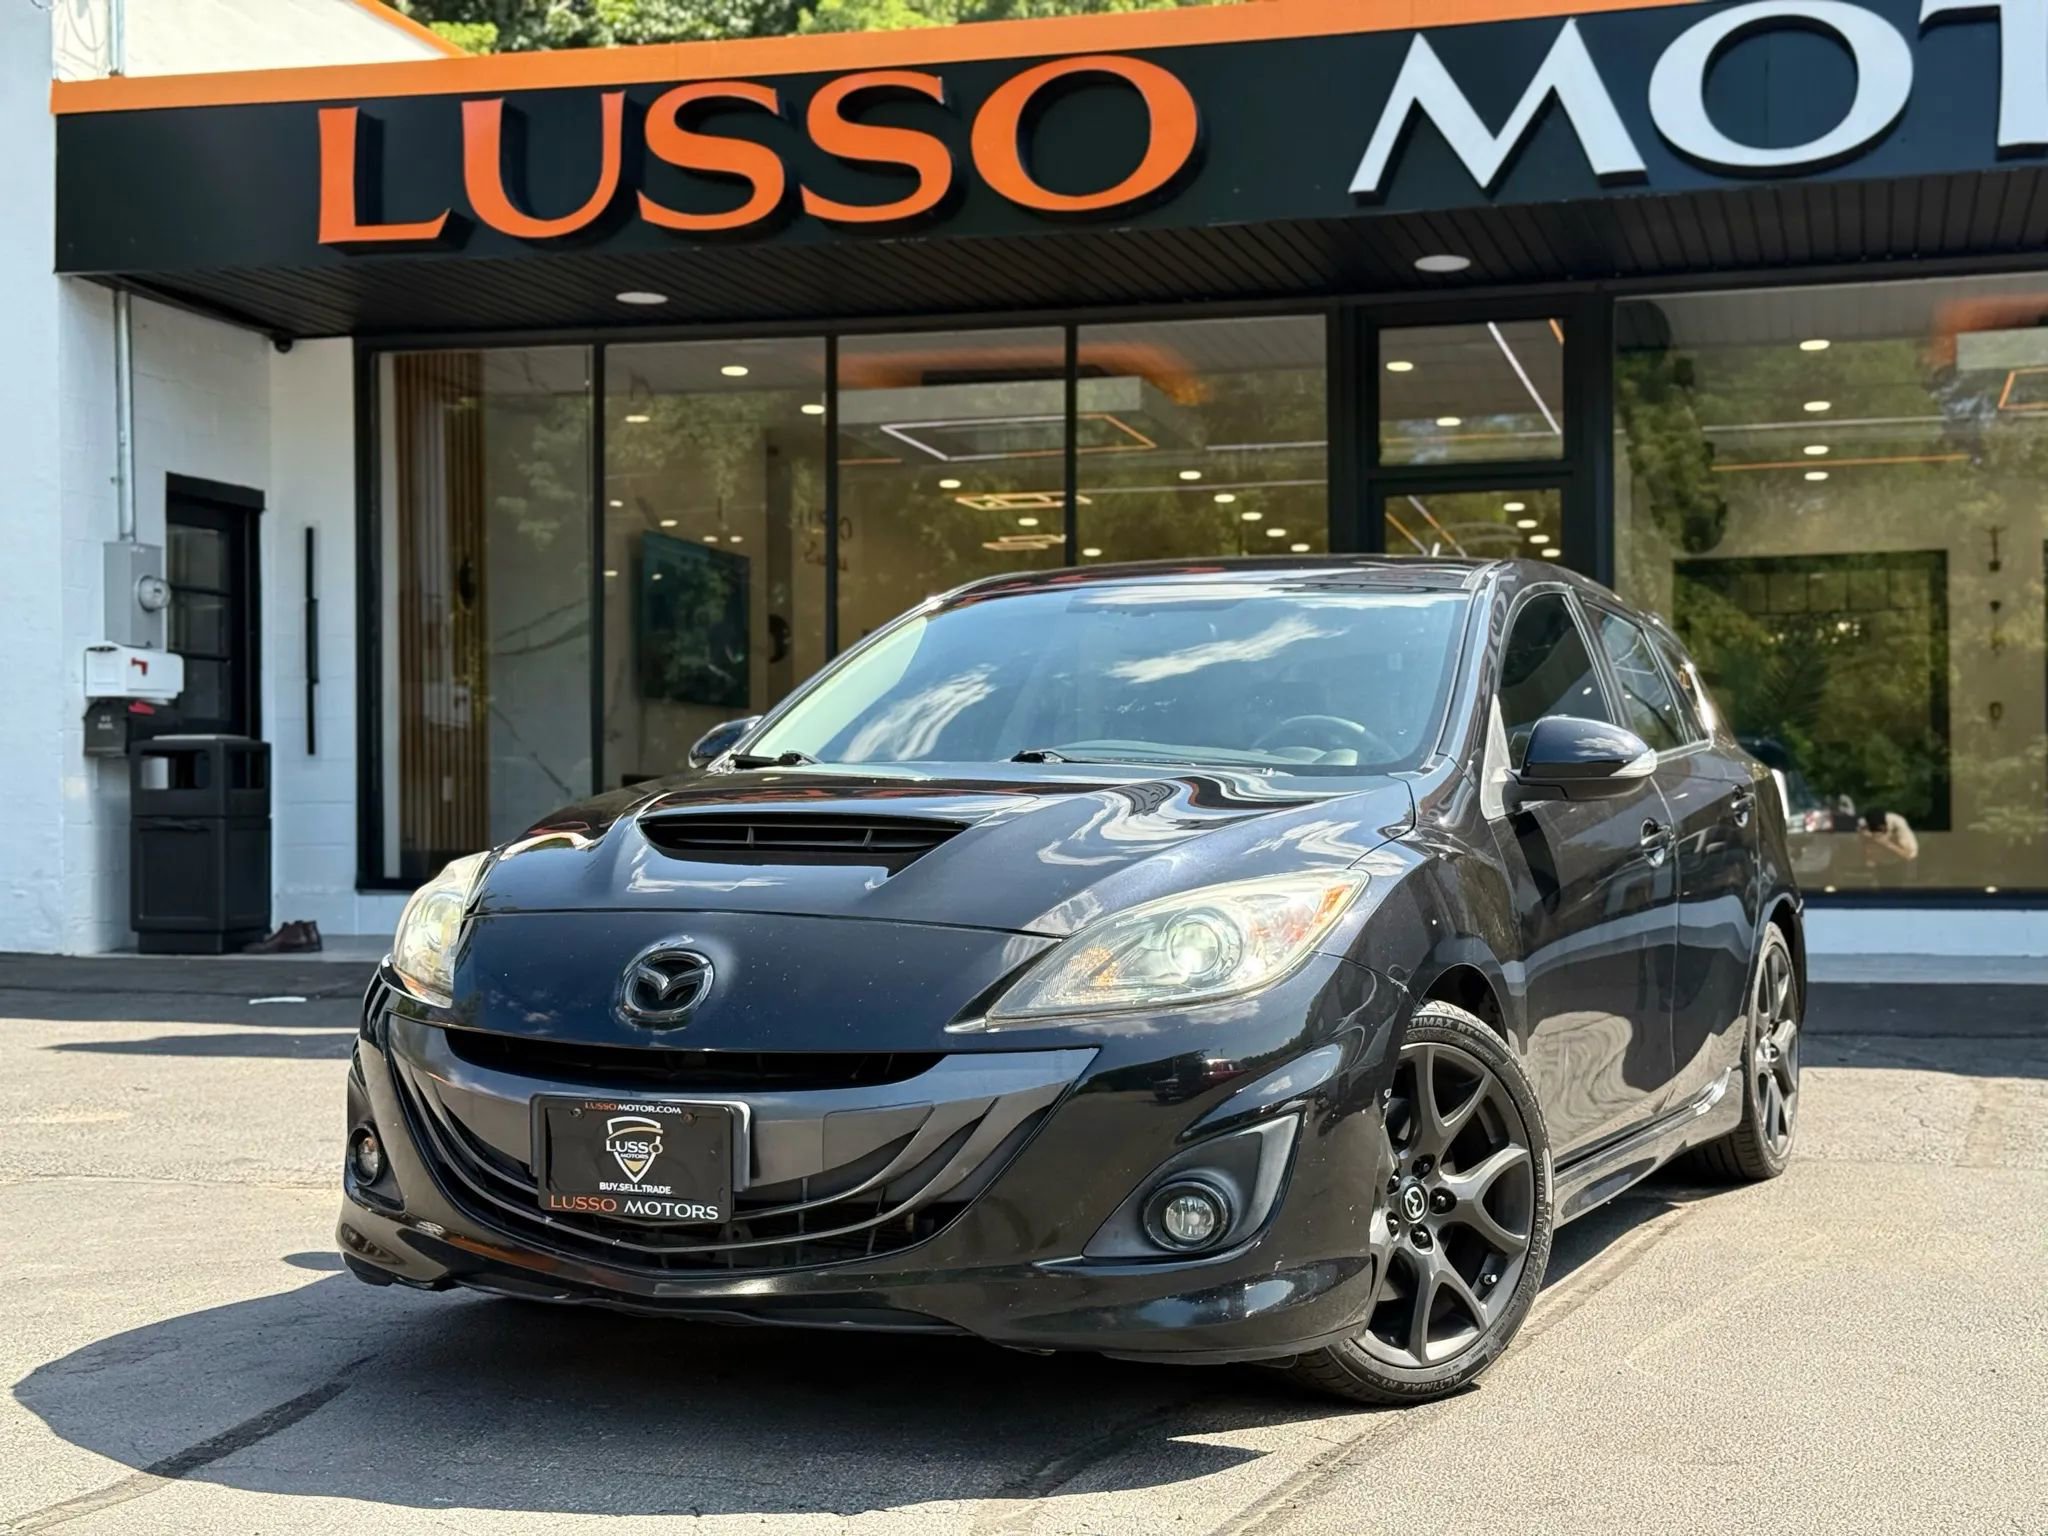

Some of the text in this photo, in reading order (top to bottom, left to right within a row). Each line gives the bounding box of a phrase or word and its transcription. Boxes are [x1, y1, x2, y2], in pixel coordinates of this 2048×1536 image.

[317, 54, 1200, 245] LUSSO
[605, 1139, 664, 1155] LUSSO
[619, 1152, 650, 1160] MOTORS
[550, 1194, 719, 1221] LUSSO MOTORS
